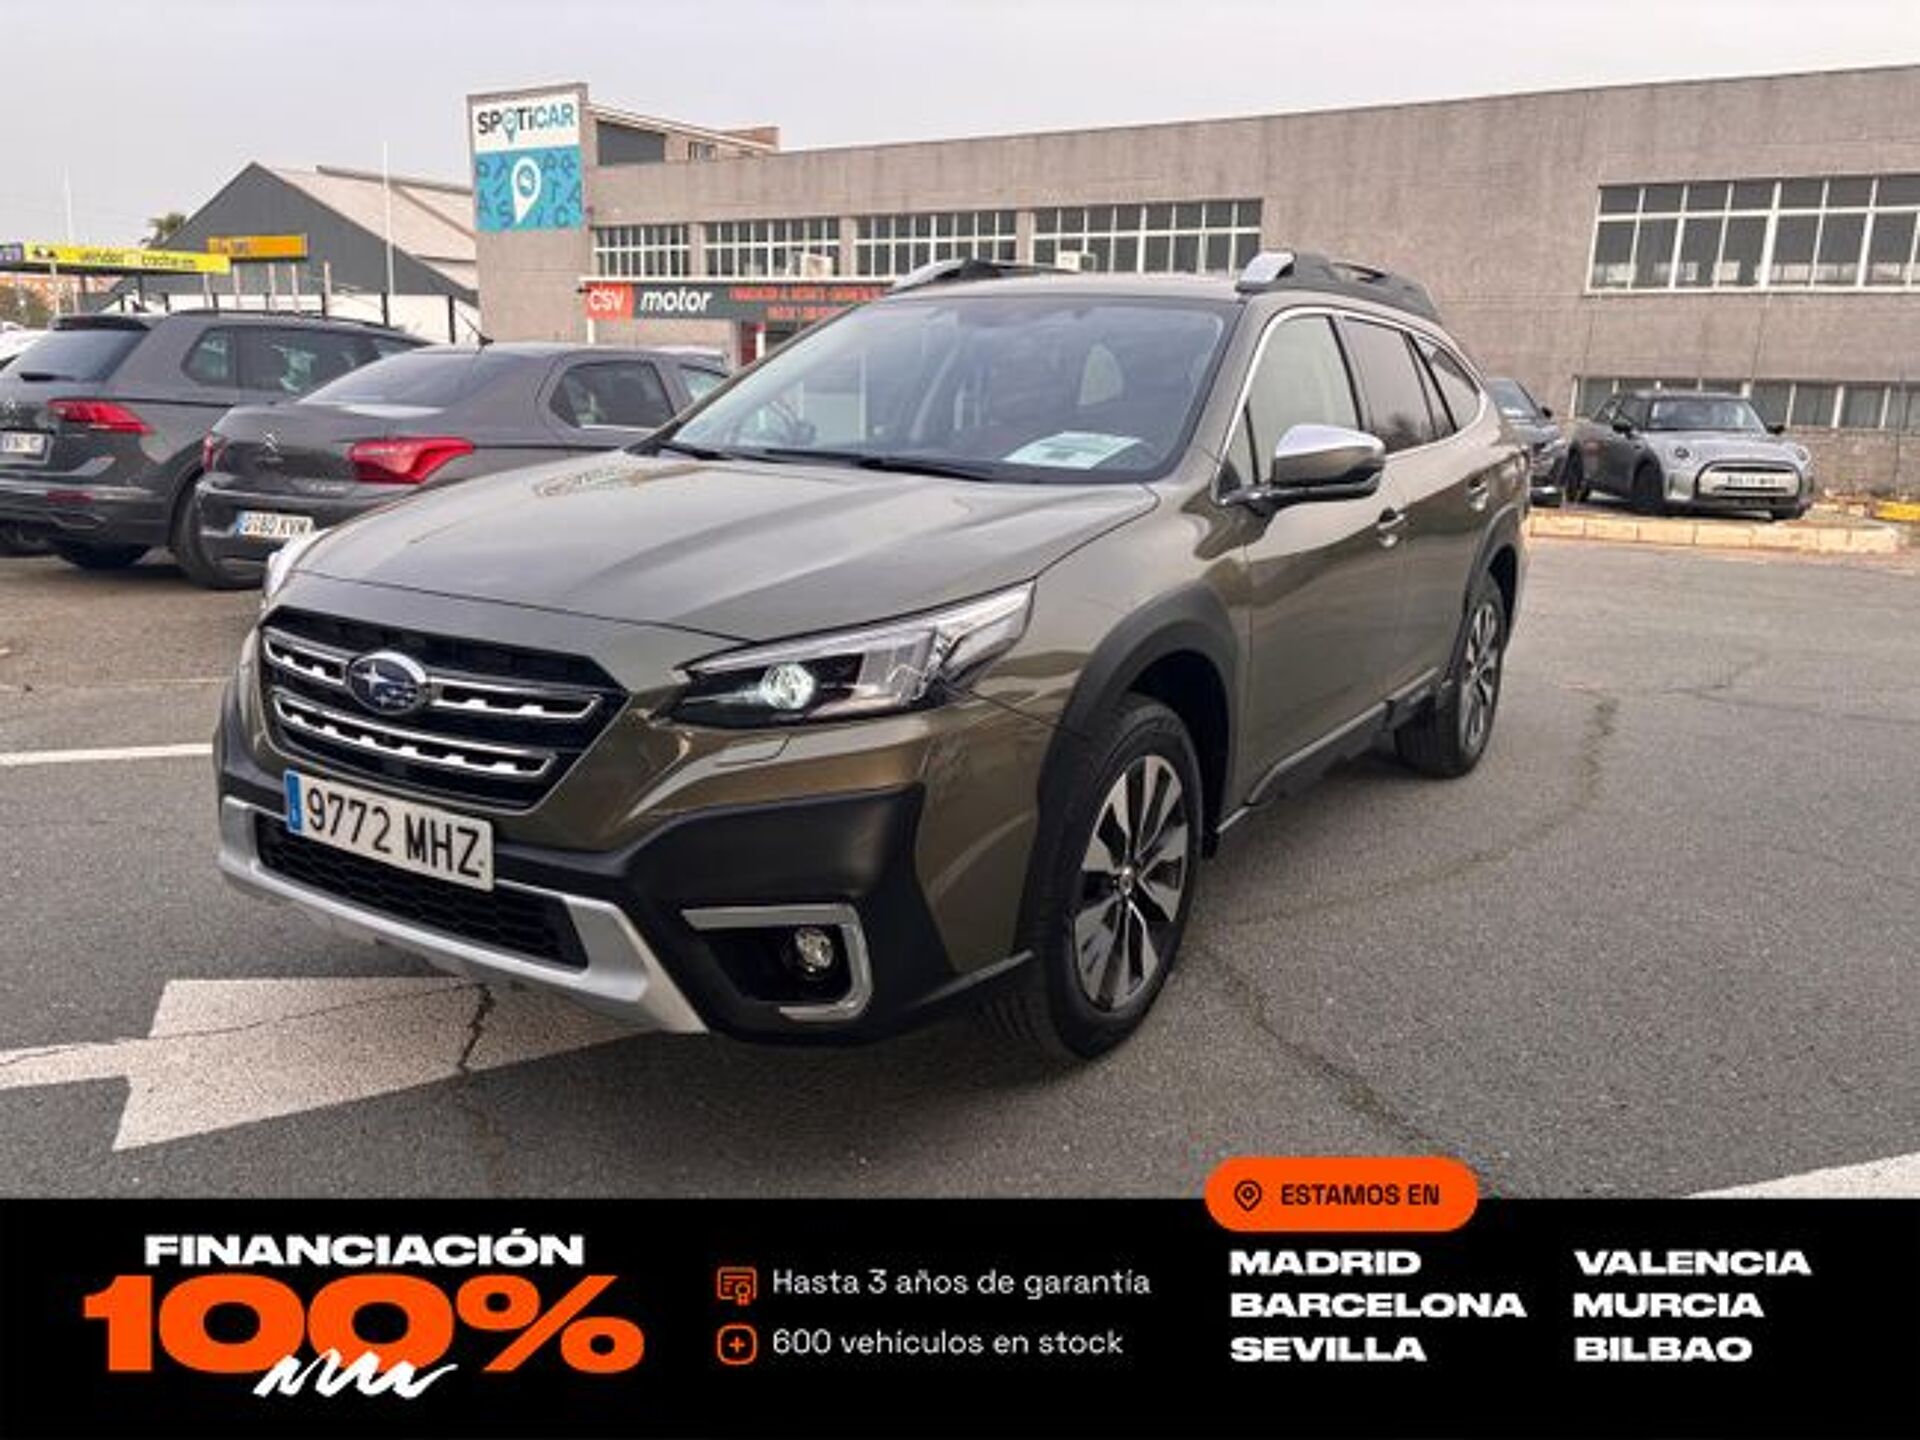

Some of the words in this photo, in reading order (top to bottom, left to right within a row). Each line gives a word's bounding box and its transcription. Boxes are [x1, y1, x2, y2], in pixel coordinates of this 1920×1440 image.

[640, 286, 713, 312] motor
[308, 787, 391, 855] 9772
[404, 813, 480, 878] MHZ
